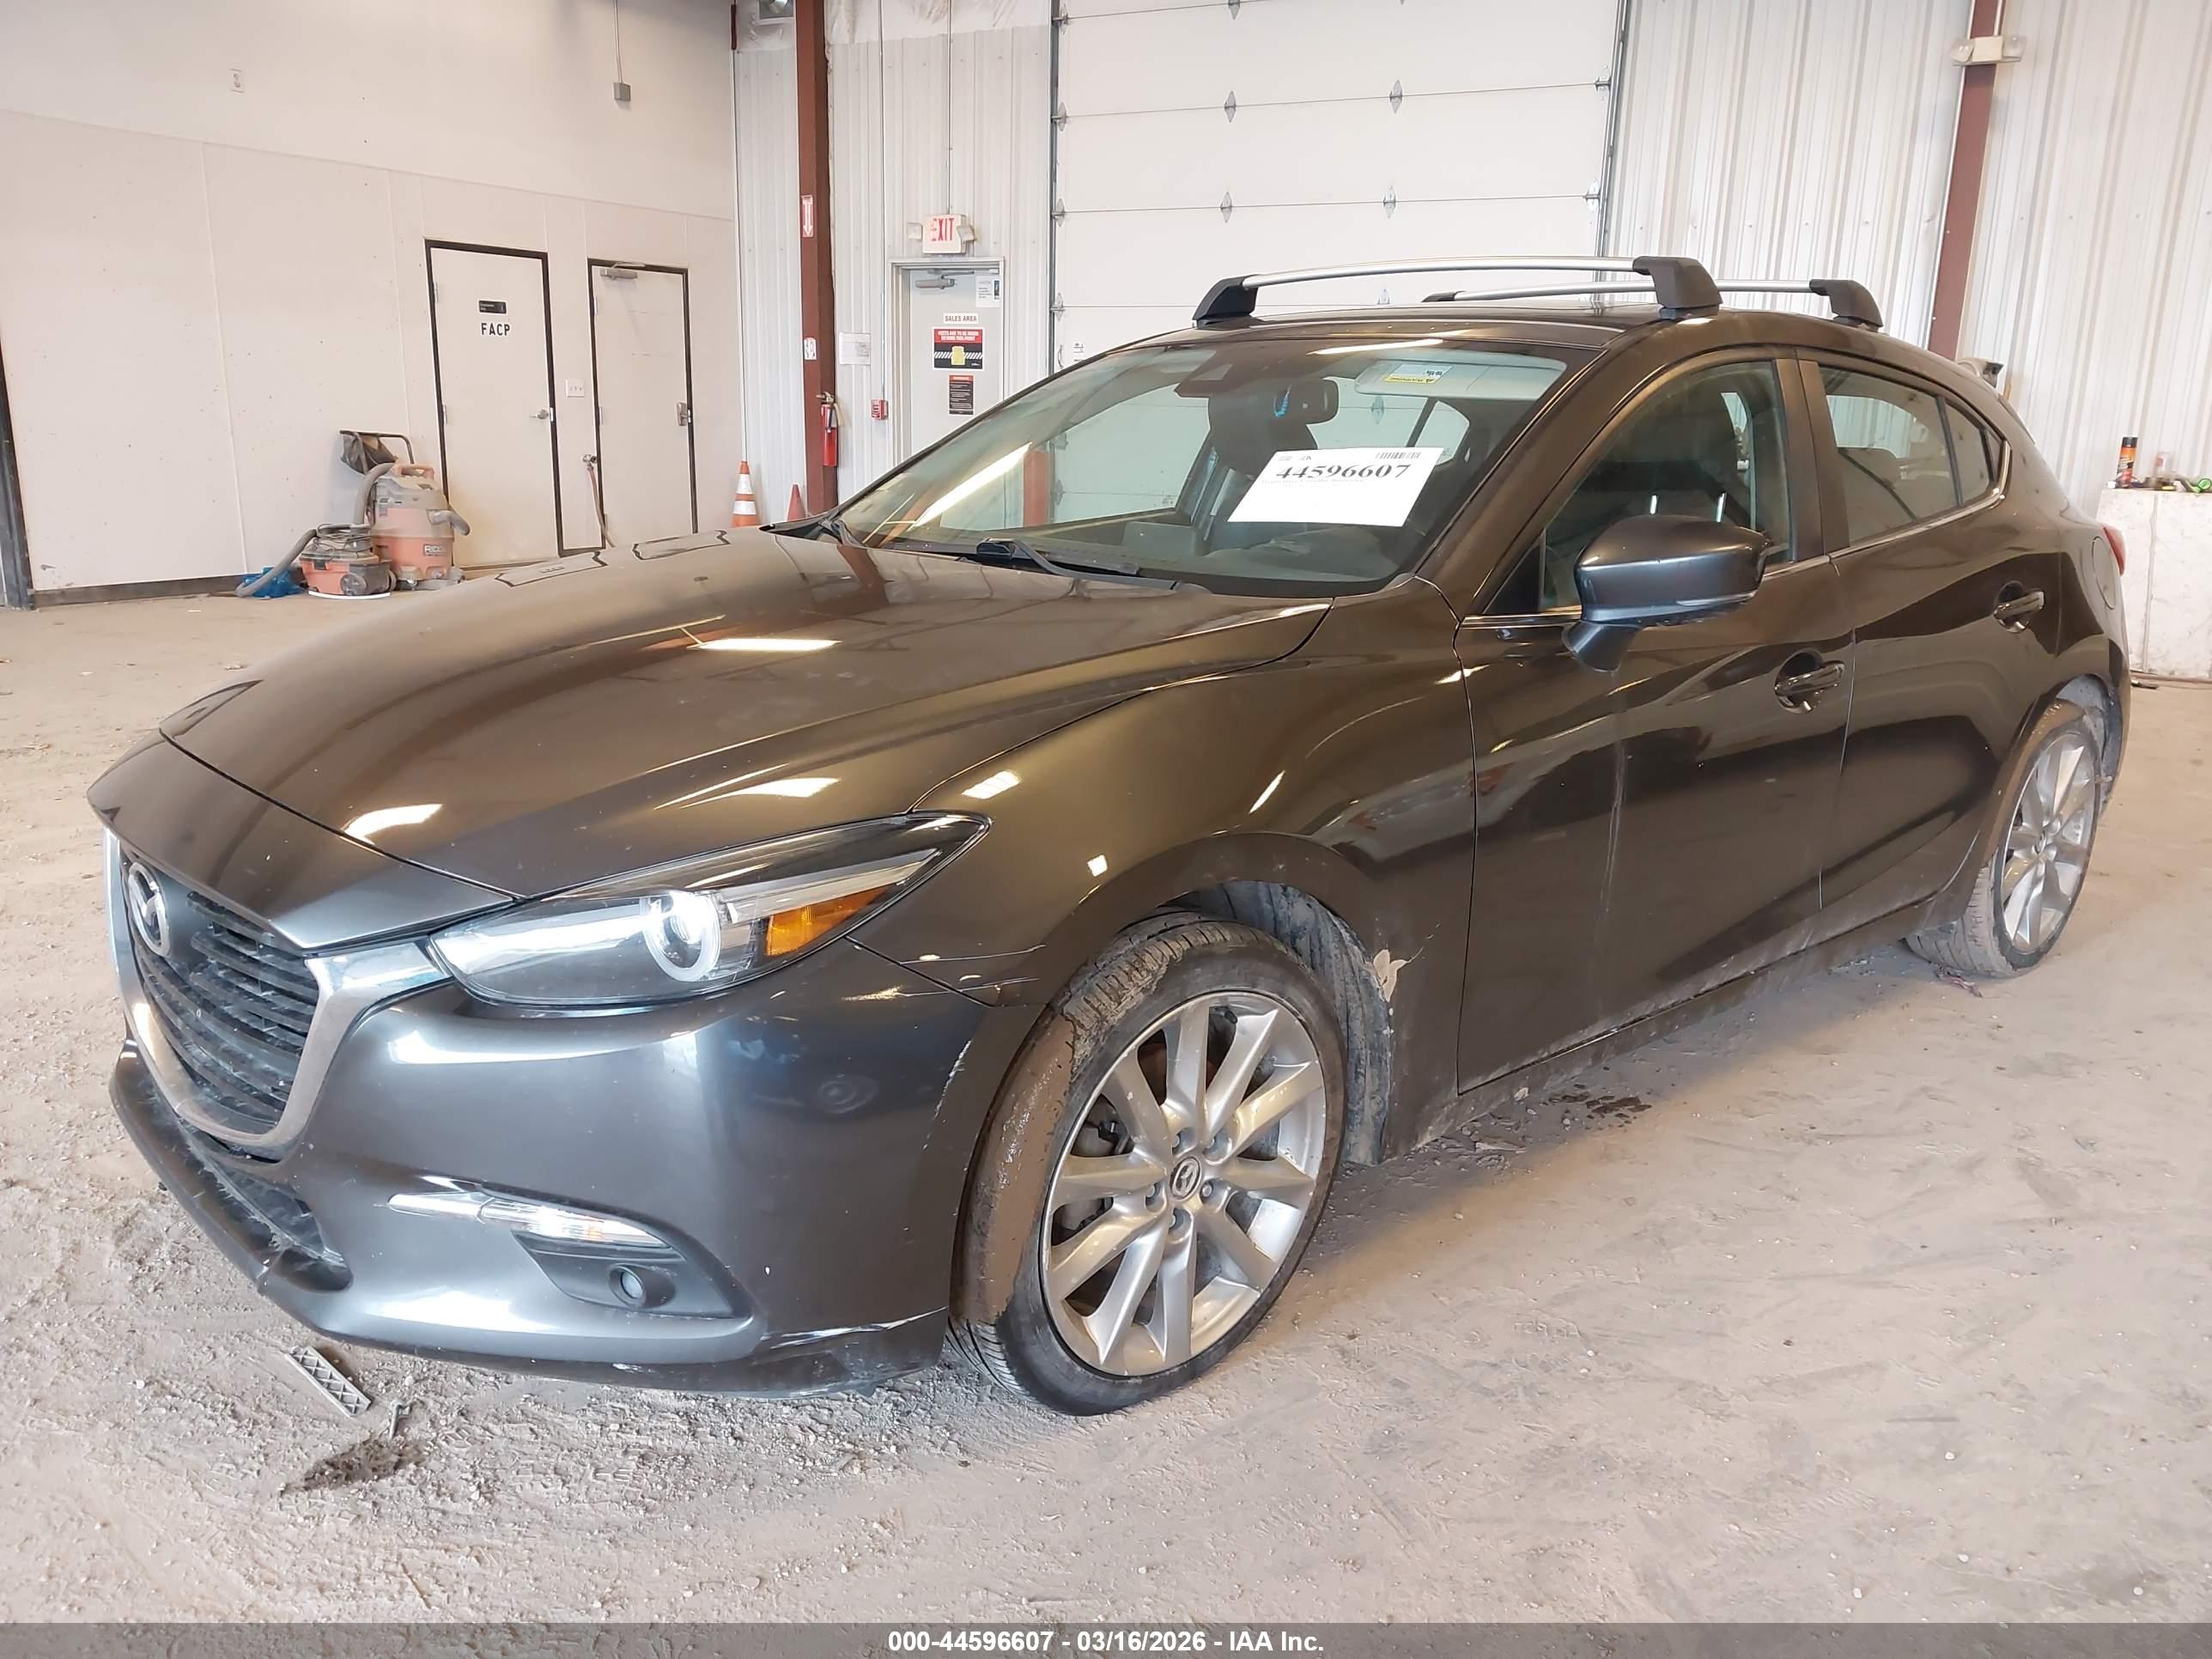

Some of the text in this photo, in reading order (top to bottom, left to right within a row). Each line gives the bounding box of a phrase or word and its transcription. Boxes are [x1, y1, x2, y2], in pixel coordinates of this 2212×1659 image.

[930, 217, 955, 241] EXIT
[481, 322, 510, 336] FACP
[1276, 464, 1412, 478] 44596607
